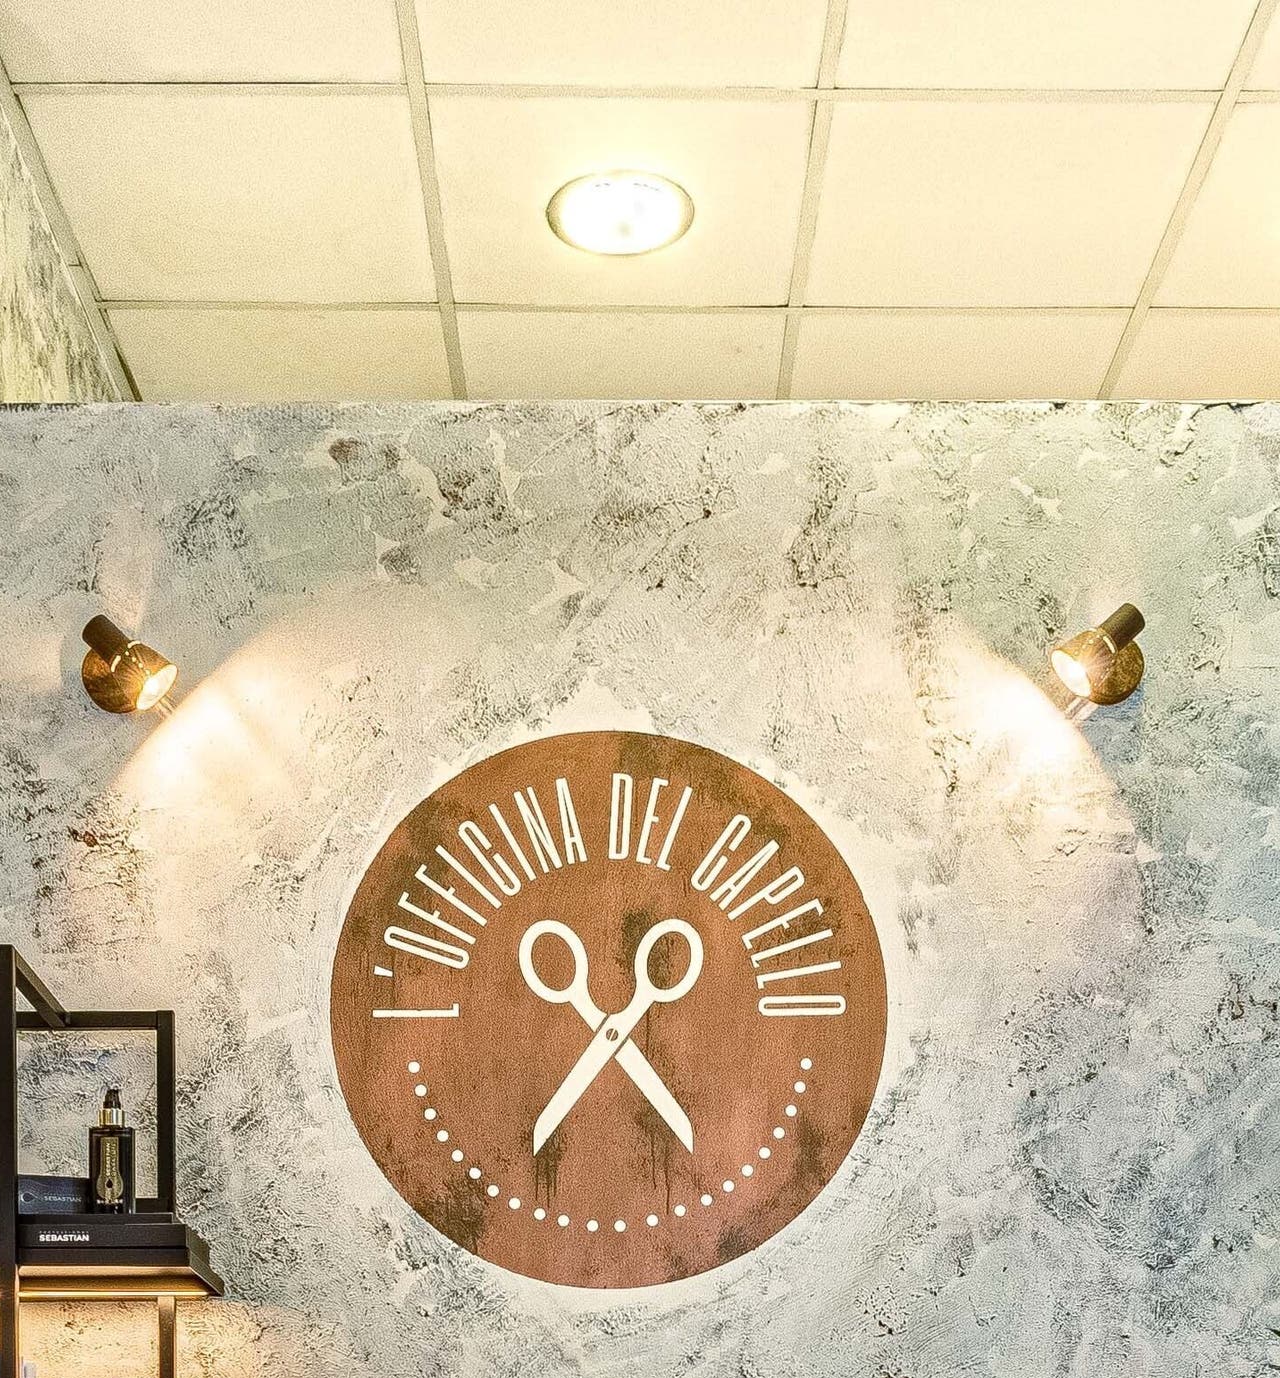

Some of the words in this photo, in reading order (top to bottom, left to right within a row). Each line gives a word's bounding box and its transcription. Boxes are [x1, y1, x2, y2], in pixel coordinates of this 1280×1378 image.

[372, 777, 588, 1019] L'OFFICINA
[608, 772, 692, 871] DEL
[692, 813, 848, 1018] CAPELLO
[39, 1234, 90, 1242] SEBASTIAN
